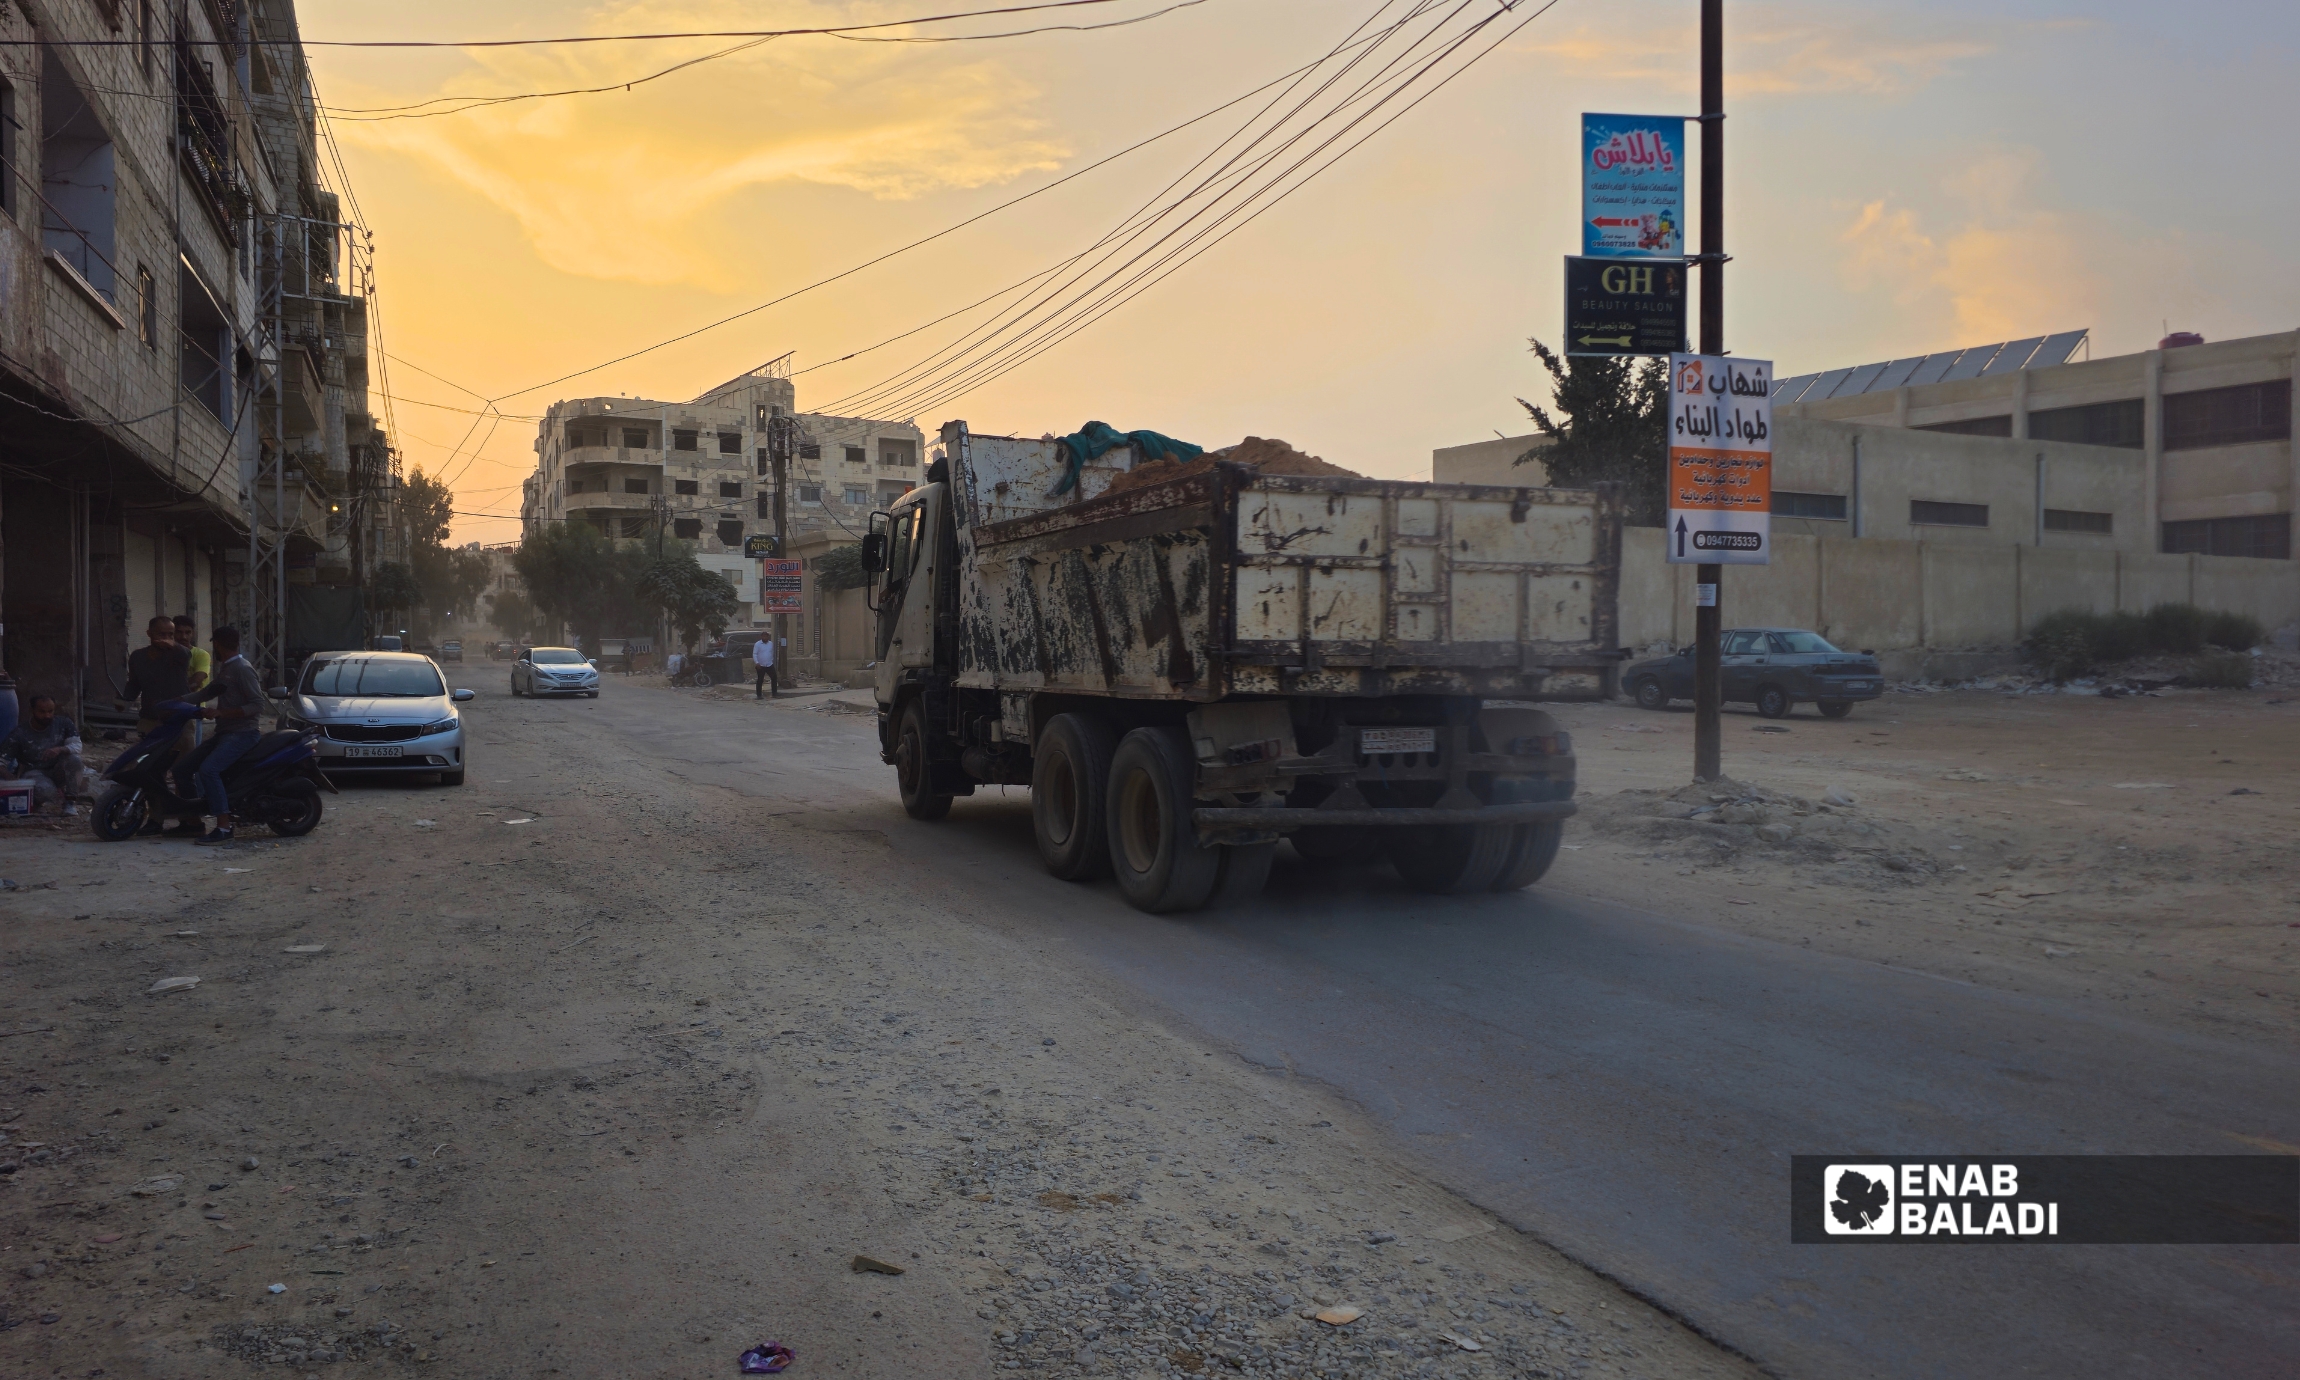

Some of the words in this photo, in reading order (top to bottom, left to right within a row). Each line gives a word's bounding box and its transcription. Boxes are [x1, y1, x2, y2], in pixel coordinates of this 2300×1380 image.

[1601, 265, 1655, 295] GH
[1582, 300, 1628, 310] BEAUTY
[1634, 301, 1673, 312] SALON
[1618, 321, 1636, 331] حلاقة
[1708, 364, 1768, 401] شهاب
[1675, 404, 1720, 443] البناء
[1725, 408, 1767, 444] لمواد
[1679, 453, 1714, 468] وحدادين
[1744, 456, 1765, 471] لوازم
[751, 542, 773, 551] KING
[1706, 534, 1758, 547] 0947735335
[767, 561, 799, 574] اللورد
[348, 748, 360, 756] 19
[371, 747, 399, 757] 46362
